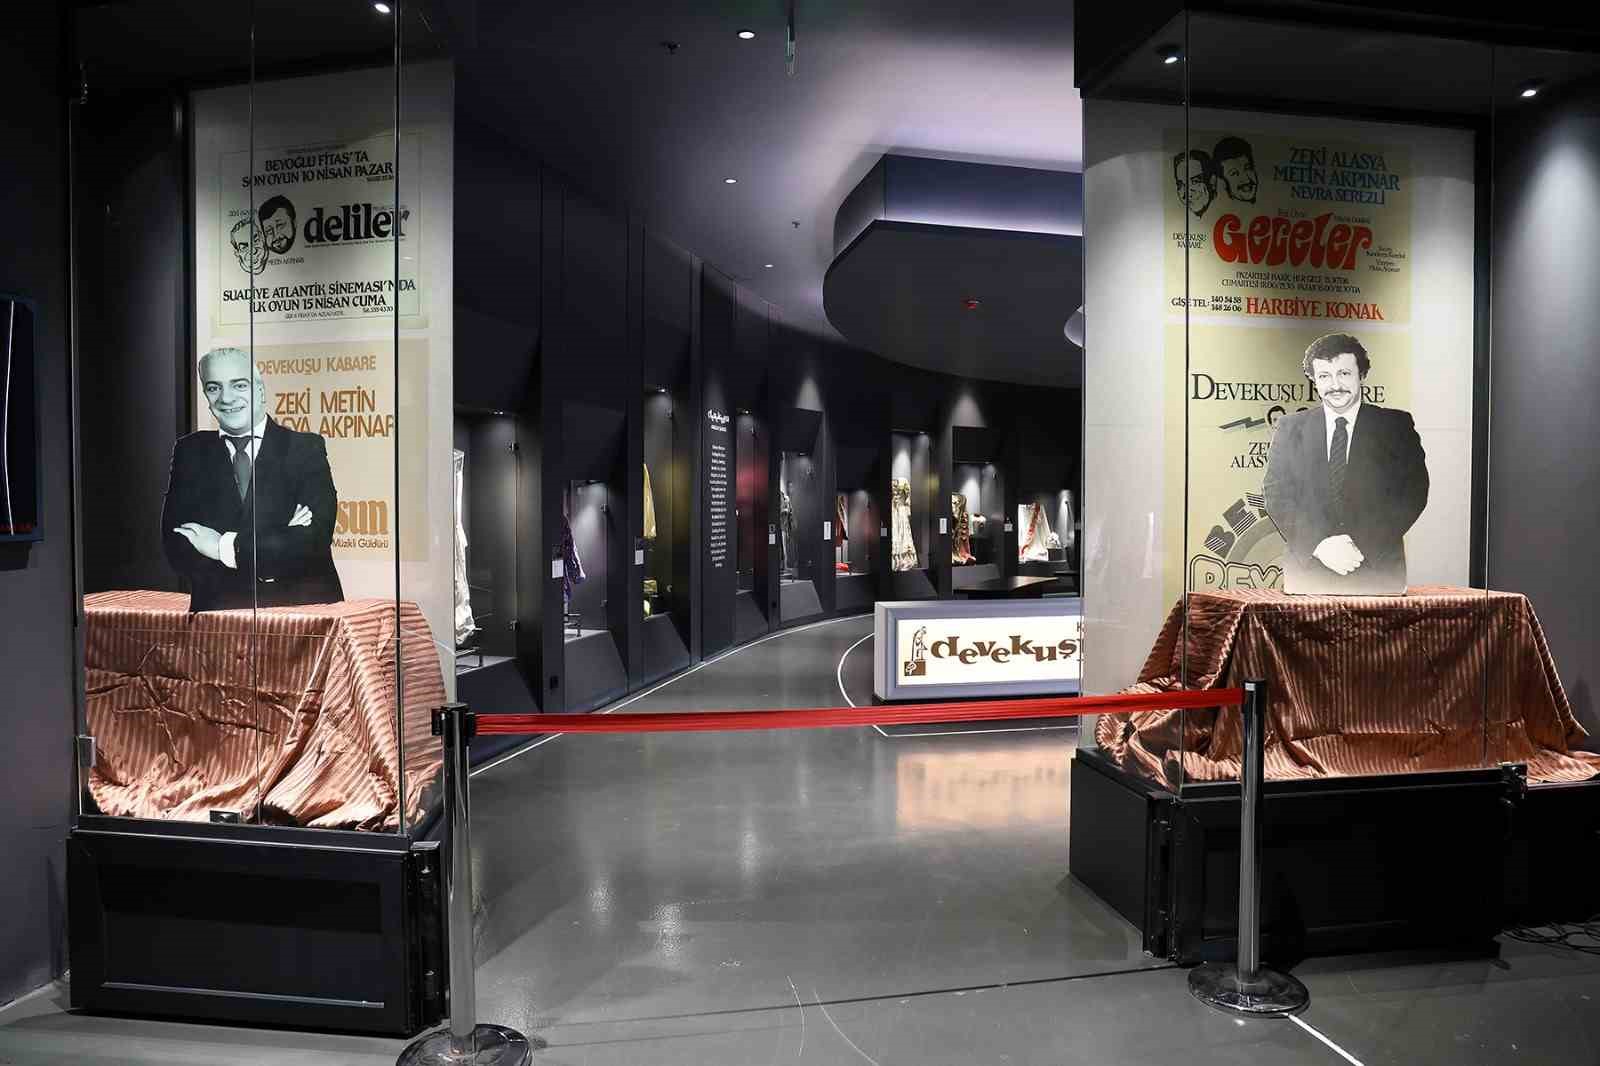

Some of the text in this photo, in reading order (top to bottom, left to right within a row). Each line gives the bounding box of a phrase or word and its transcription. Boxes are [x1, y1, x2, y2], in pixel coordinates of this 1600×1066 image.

[267, 171, 300, 186] OYUN
[317, 165, 353, 181] NİSAN
[355, 161, 394, 177] PAZAR
[303, 203, 410, 244] deliler
[268, 299, 300, 312] OYUN
[302, 297, 314, 310] 15
[315, 295, 350, 309] NİSAN
[352, 294, 387, 307] CUMA
[272, 281, 326, 300] ATLANTİK
[1246, 296, 1385, 321] HARBİYE KONAK
[326, 355, 376, 372] KABARE
[275, 386, 376, 415] ZEKİ METİN
[336, 500, 389, 535] sun
[930, 635, 1081, 664] devekuş
